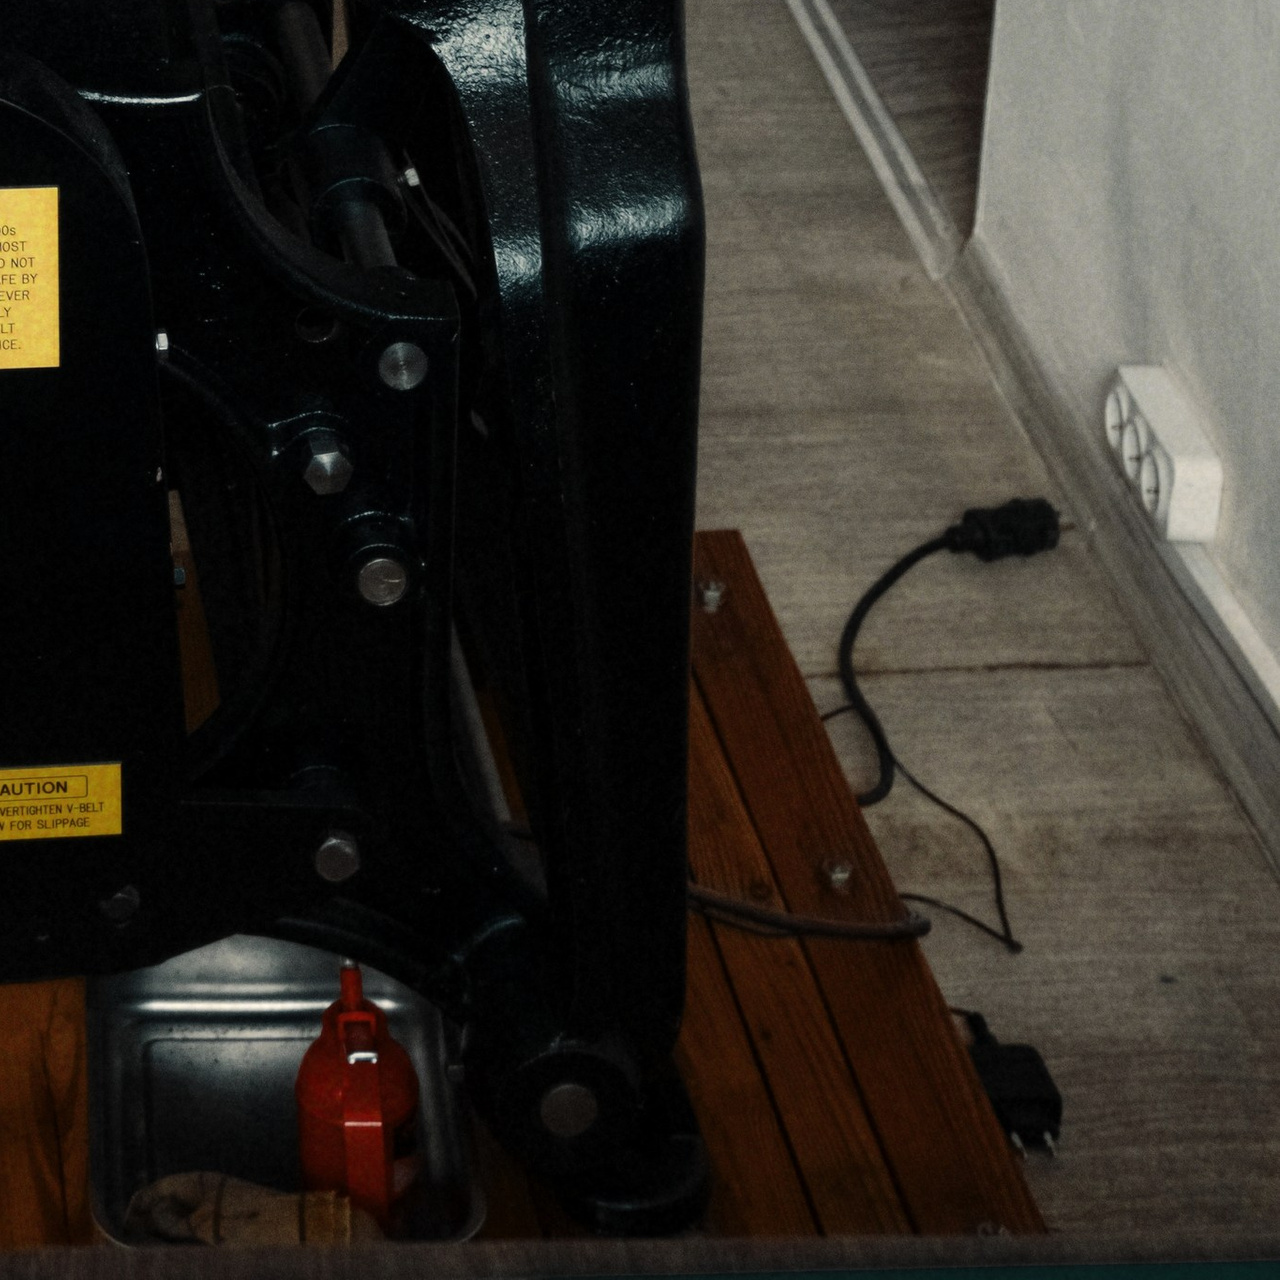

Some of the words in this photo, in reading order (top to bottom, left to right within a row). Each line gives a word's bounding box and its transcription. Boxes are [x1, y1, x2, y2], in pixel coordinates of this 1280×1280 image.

[10, 256, 35, 268] NOT
[21, 273, 38, 284] BY
[66, 801, 104, 813] V-BELT
[10, 820, 32, 830] FOR
[37, 817, 90, 829] SLIPPAGE
